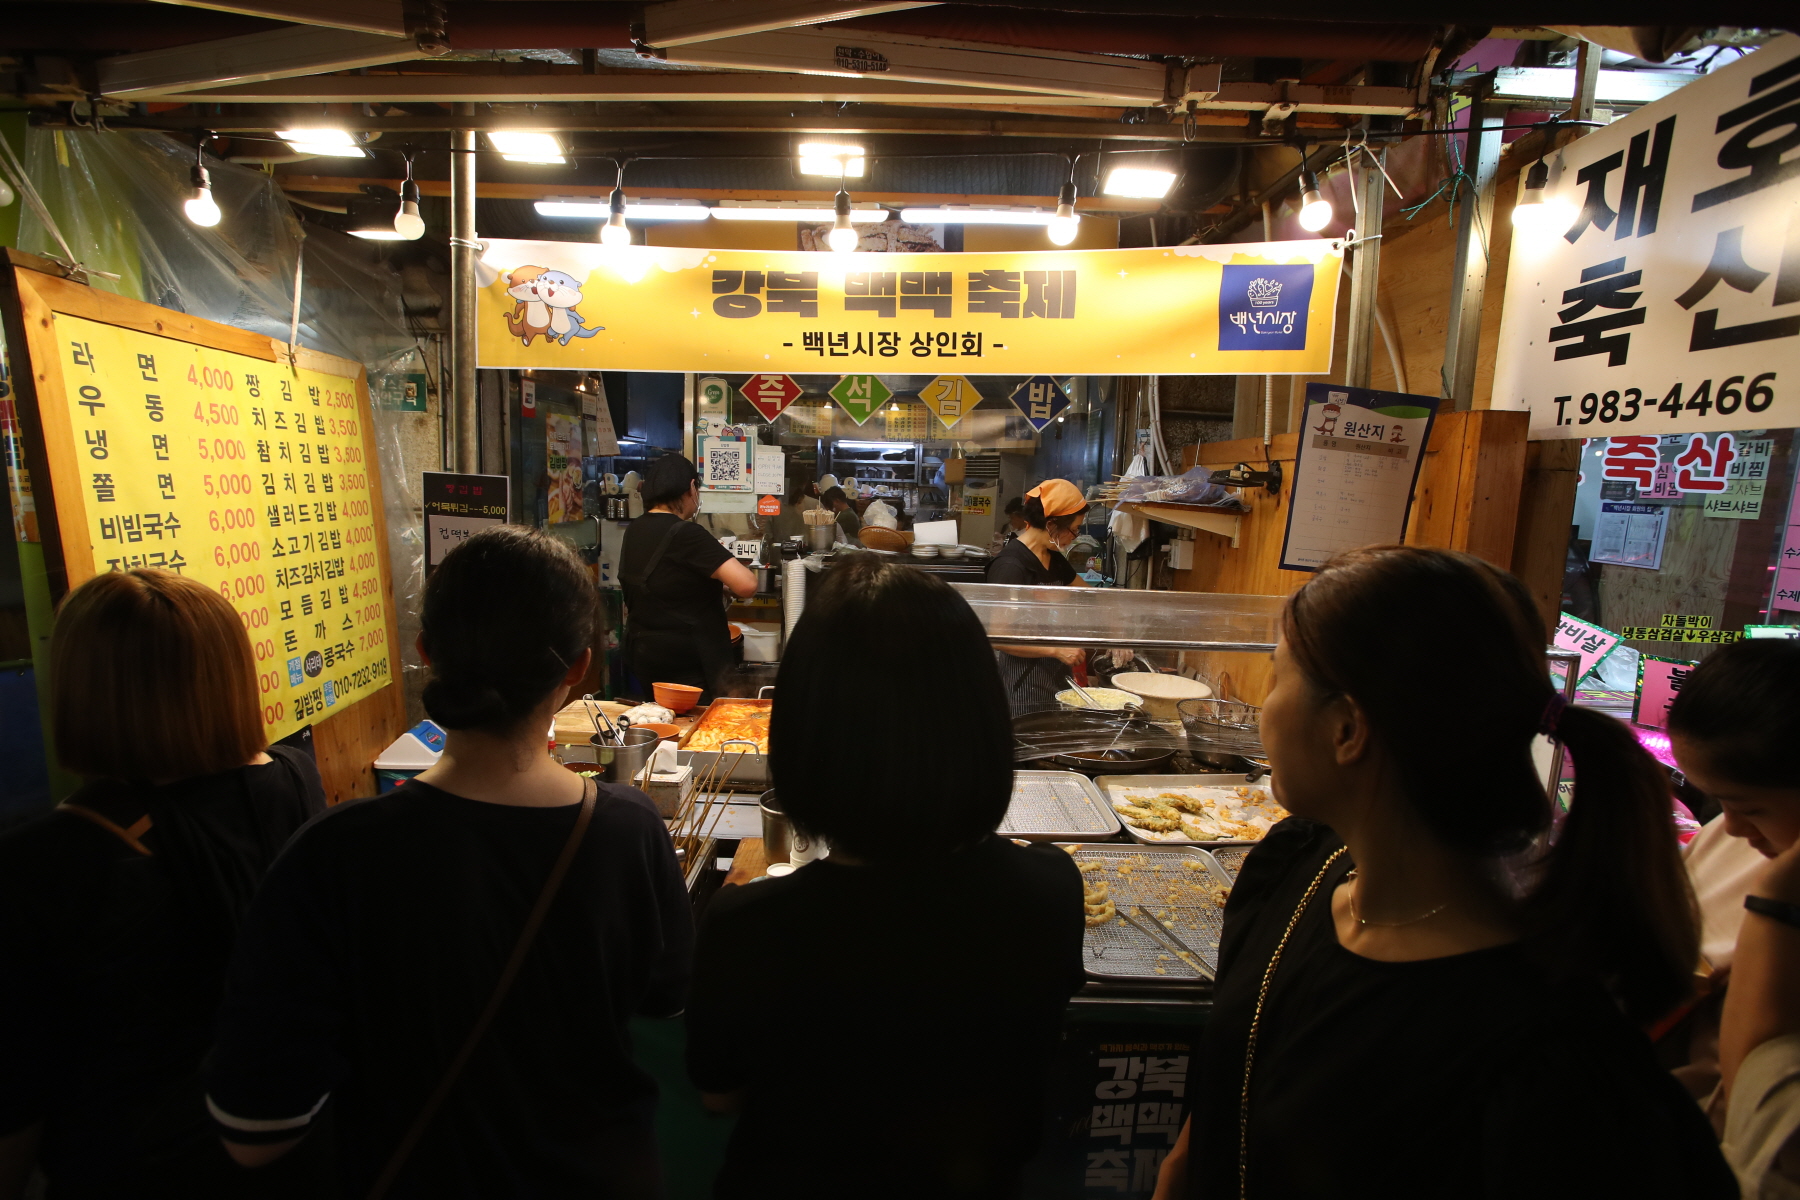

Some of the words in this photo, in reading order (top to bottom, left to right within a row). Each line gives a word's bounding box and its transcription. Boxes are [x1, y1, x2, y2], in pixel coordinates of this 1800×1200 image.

[712, 269, 819, 318] 강북
[844, 270, 953, 318] 백맥
[968, 269, 1077, 319] 축제
[1229, 310, 1297, 335] 백년시장
[802, 331, 901, 357] 백년시장
[910, 331, 984, 358] 상인회
[187, 363, 234, 392] 4,000
[325, 387, 354, 410] 2,500
[193, 402, 239, 428] 4,500
[328, 416, 358, 438] 3,500
[1343, 420, 1386, 441] 원산지
[198, 437, 246, 464] 5,000
[333, 445, 362, 465] 3,500
[203, 473, 252, 499] 5,000
[338, 470, 366, 492] 3,500
[341, 499, 370, 520] 4,000
[1705, 499, 1760, 514] 샤브샤브
[99, 511, 182, 545] 비빔국수
[208, 507, 256, 535] 6,000
[214, 541, 261, 569] 6,000
[271, 528, 343, 560] 소고기김밥
[345, 525, 373, 549] 4,000
[275, 556, 346, 590] 치즈김치김밥
[349, 551, 376, 574] 4,000
[352, 577, 379, 602] 4,500
[355, 603, 382, 626] 7,000
[1662, 614, 1713, 628] 차돌박이
[324, 640, 356, 668] 콩국수
[359, 627, 385, 653] 7,000
[294, 686, 324, 722] 김밥짱
[1095, 1056, 1190, 1100] 강북
[1090, 1102, 1183, 1145] 백맥
